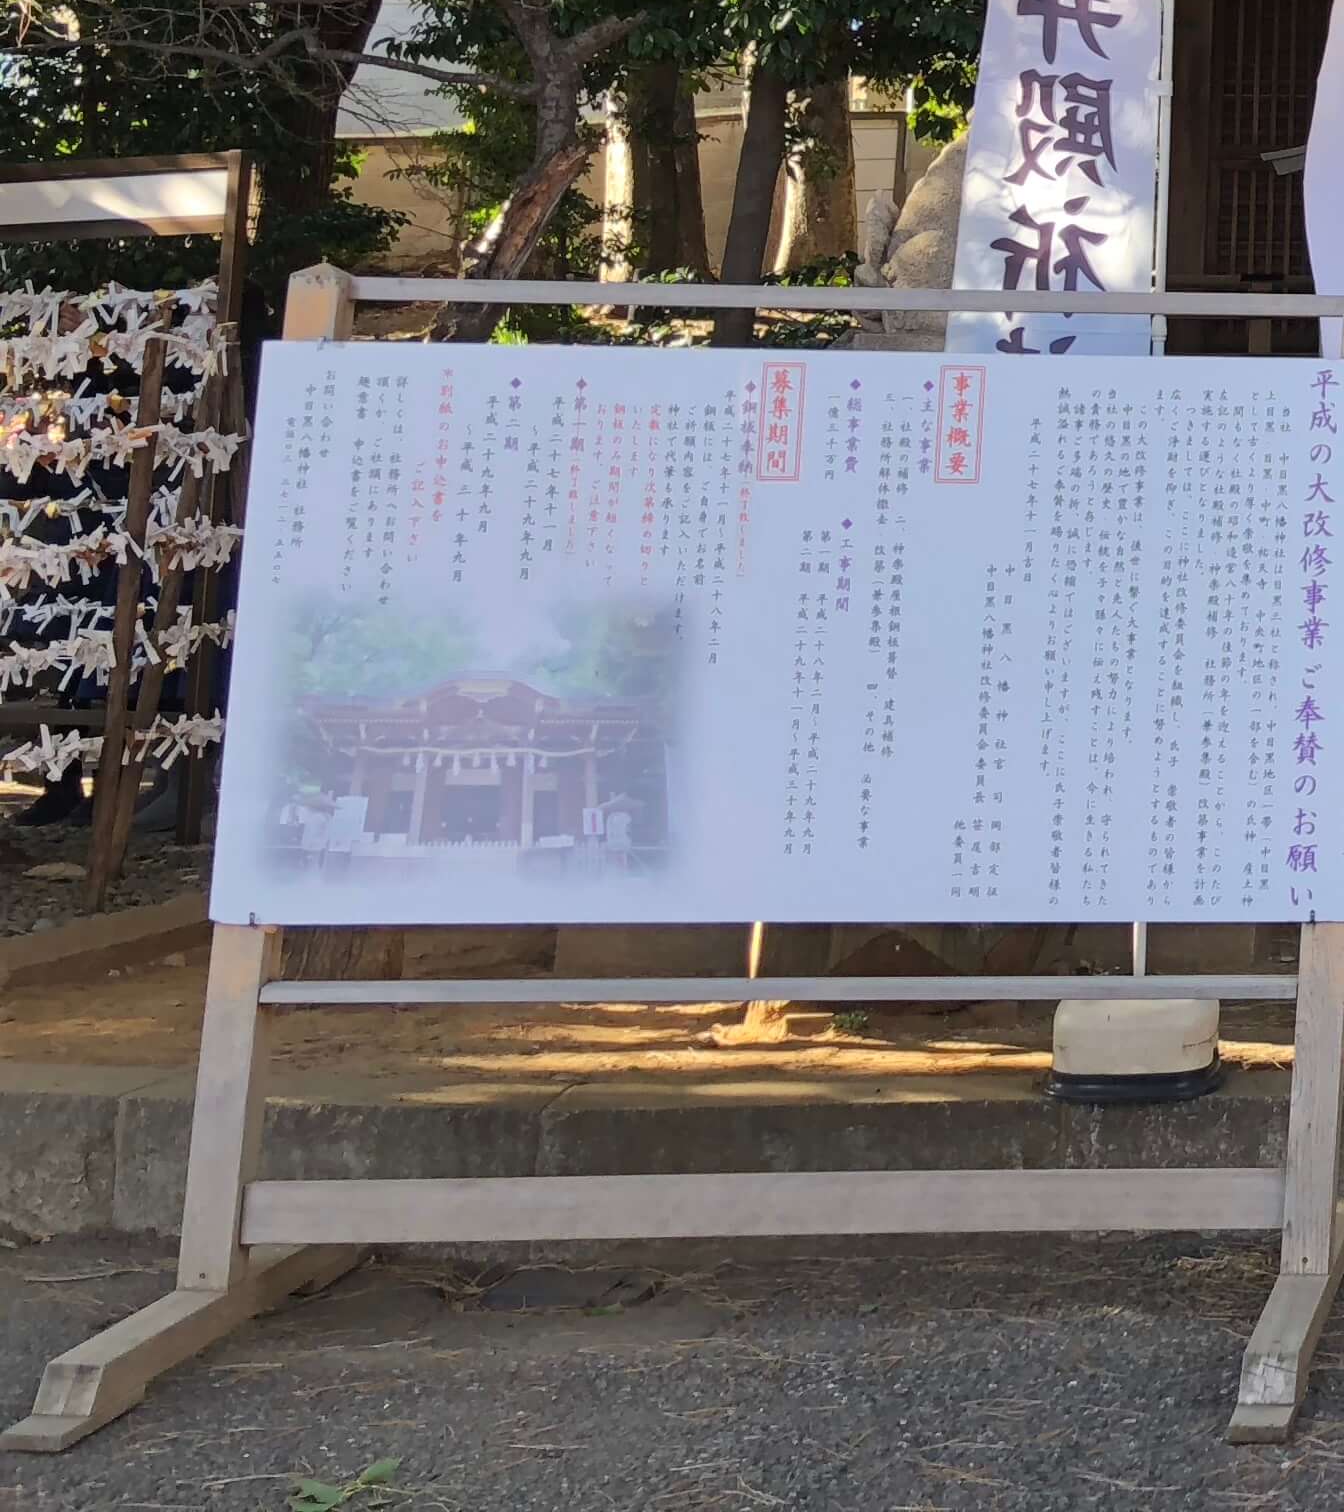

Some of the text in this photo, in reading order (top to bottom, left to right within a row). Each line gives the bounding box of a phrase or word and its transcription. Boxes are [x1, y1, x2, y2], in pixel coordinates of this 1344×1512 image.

[503, 395, 522, 451] 第二期
[767, 369, 794, 473] 募集期間
[823, 395, 841, 481] 一億三千万円
[844, 397, 862, 474] 総事業費
[917, 397, 939, 475] 主な事業
[945, 371, 974, 476] 事業概要
[835, 538, 854, 613] 工事期間
